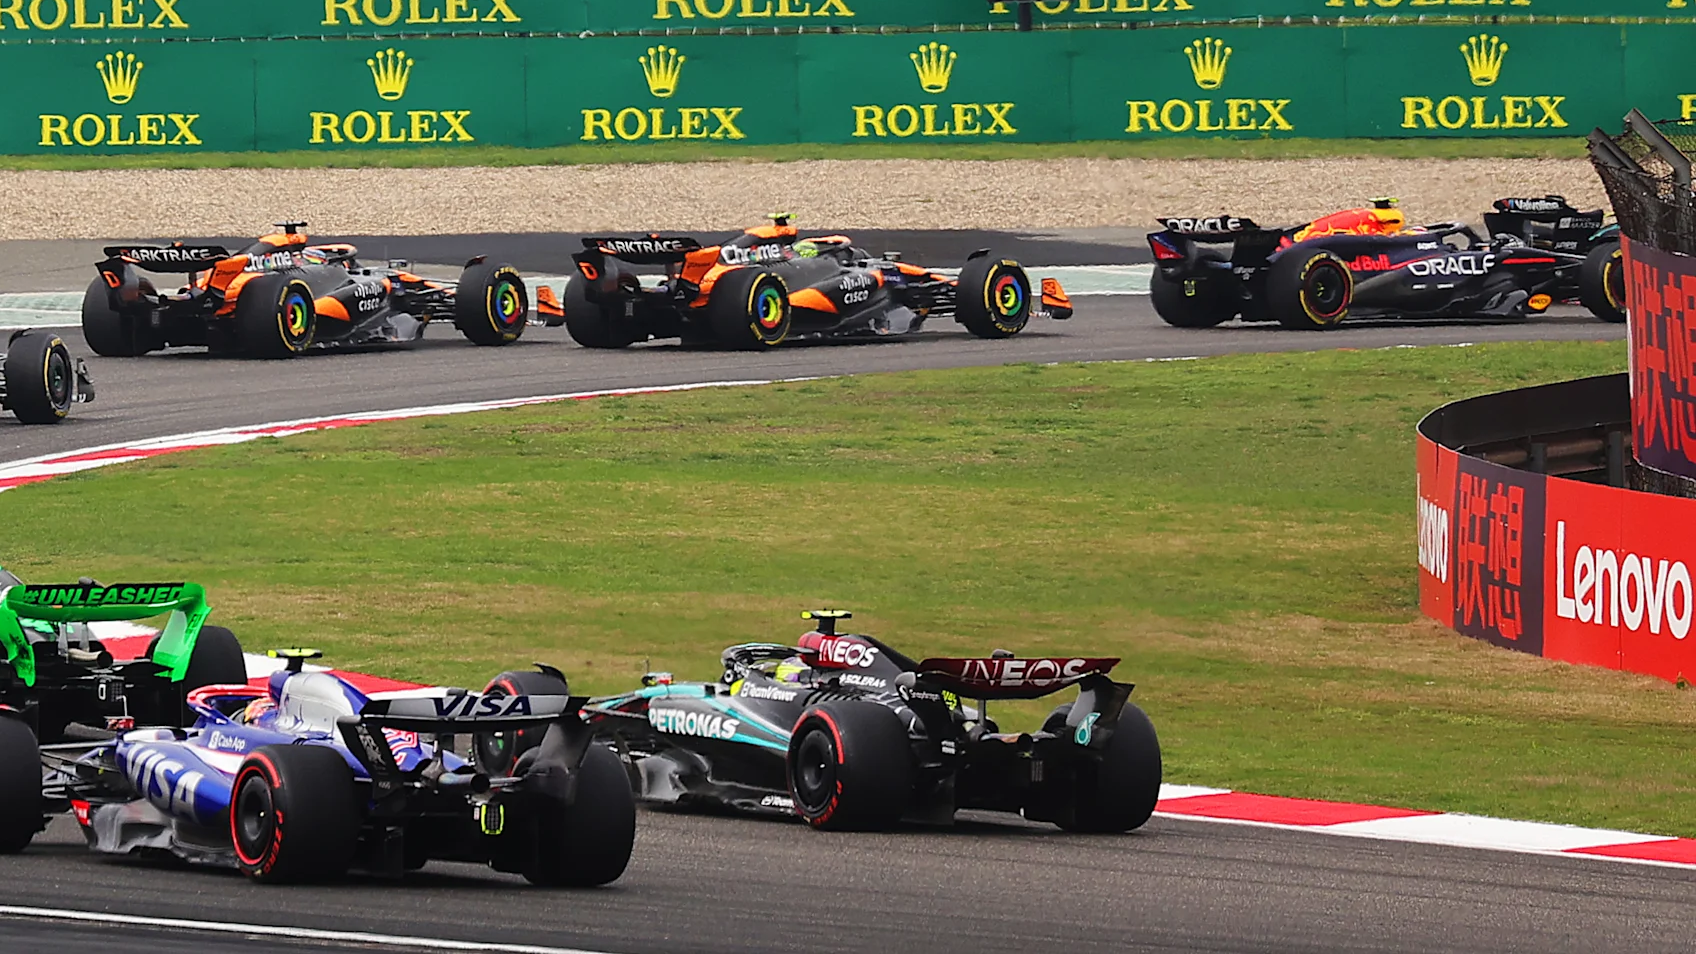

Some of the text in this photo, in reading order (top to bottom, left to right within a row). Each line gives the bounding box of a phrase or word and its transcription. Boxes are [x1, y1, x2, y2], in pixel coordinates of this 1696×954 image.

[311, 110, 473, 143] ROLEX
[582, 107, 744, 140] ROLEX
[854, 103, 1016, 137] ROLEX
[1126, 99, 1292, 133] ROLEX
[1401, 96, 1568, 129] ROLEX
[40, 113, 202, 146] ROLEX
[1166, 218, 1242, 233] ORACLE
[721, 244, 781, 264] Chrome
[1362, 253, 1391, 271] Bull
[1457, 472, 1525, 641] 联想
[1556, 520, 1693, 640] Lenovo
[819, 639, 879, 668] INEOS
[960, 659, 1087, 686] INEOS
[433, 695, 533, 717] VISA
[750, 683, 798, 702] TeamViewer
[648, 707, 741, 740] PETRONAS
[218, 734, 246, 752] Cash App
[126, 743, 205, 816] VISA
